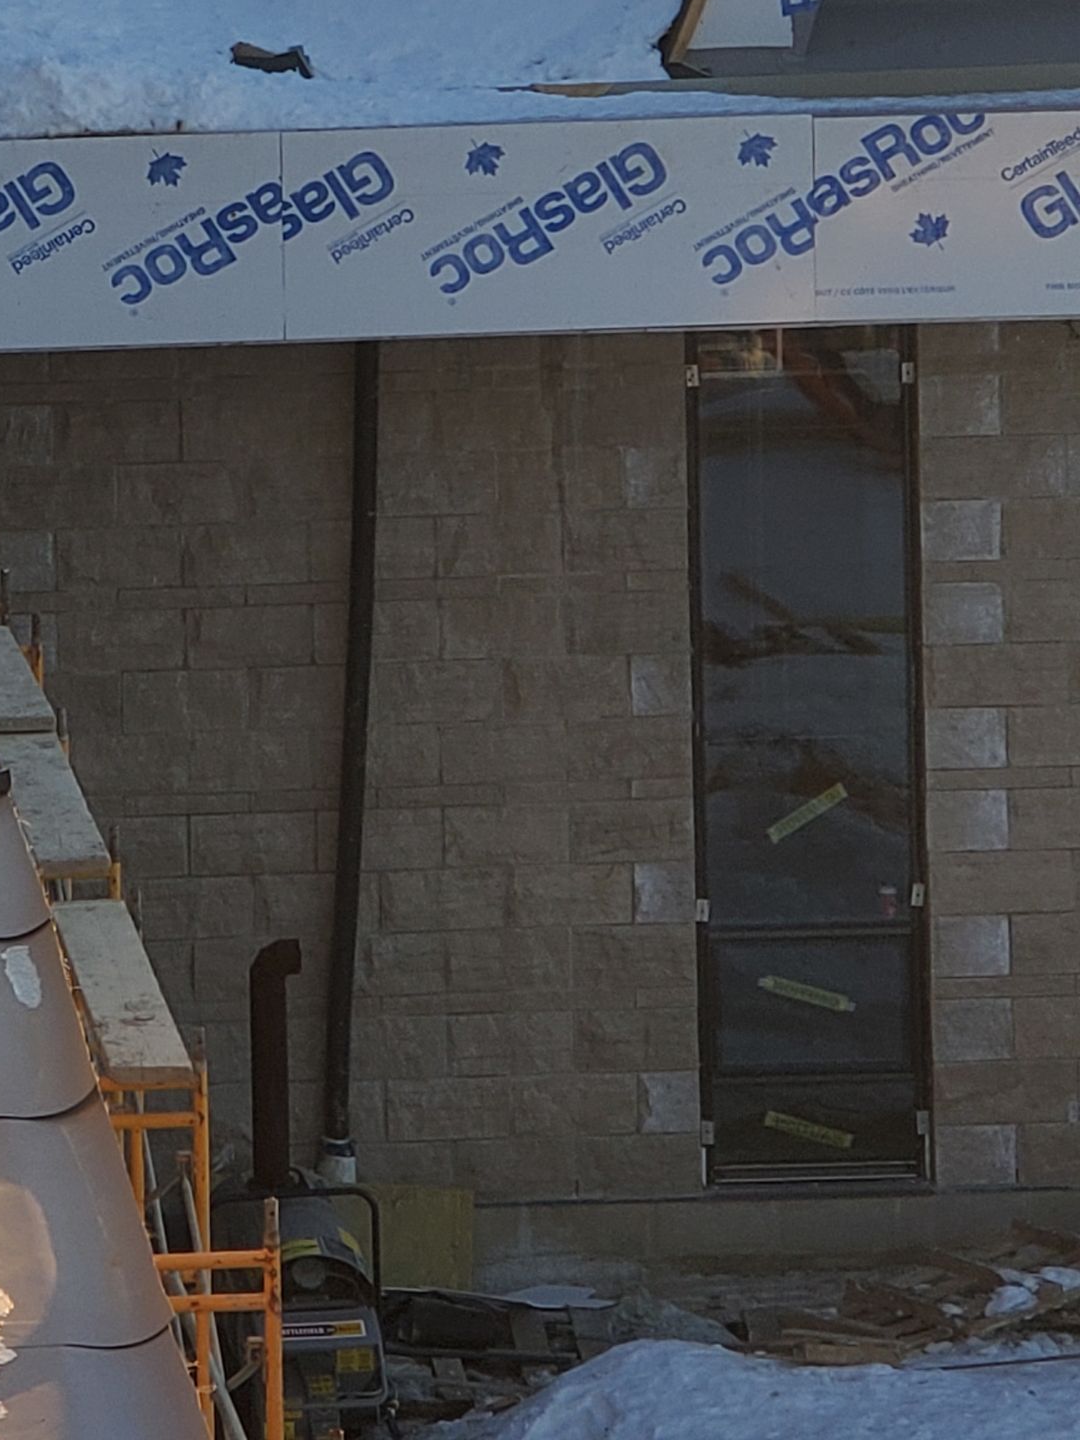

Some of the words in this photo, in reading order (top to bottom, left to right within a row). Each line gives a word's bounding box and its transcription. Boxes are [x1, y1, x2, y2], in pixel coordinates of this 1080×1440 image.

[331, 208, 414, 264] CertainTeed
[429, 141, 668, 294] GlasRoc
[603, 198, 687, 255] CertainTeed
[11, 218, 95, 275] CertainTeed
